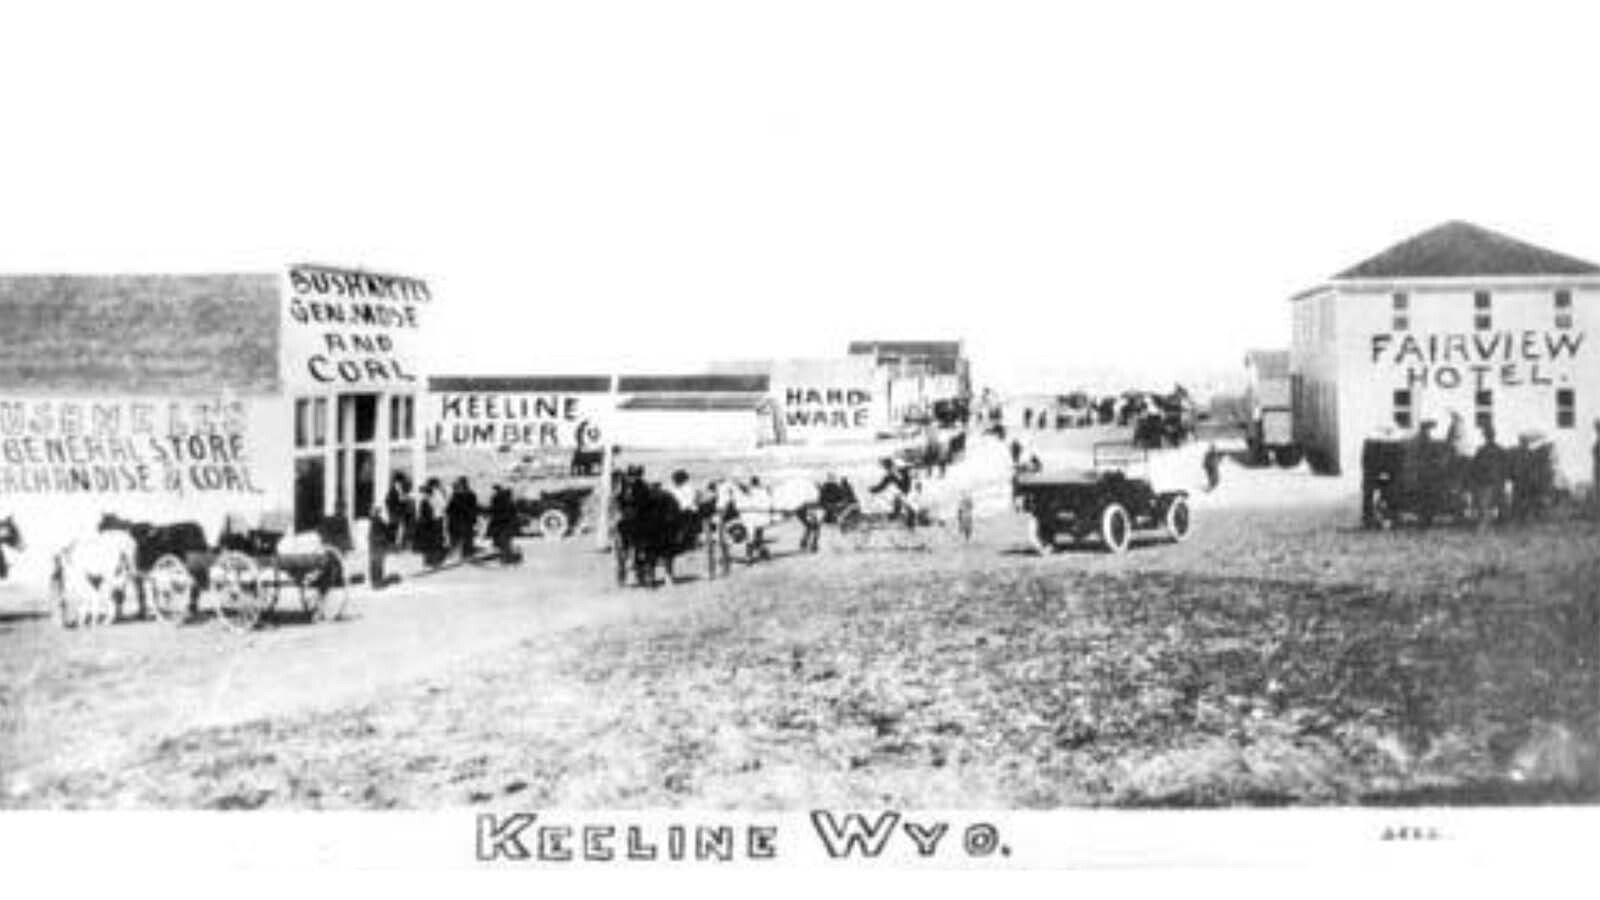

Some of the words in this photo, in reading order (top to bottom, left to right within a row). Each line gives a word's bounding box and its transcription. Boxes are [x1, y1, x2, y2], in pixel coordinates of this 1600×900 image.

[325, 333, 392, 354] AND
[1371, 331, 1586, 363] FAIRVIEW
[308, 354, 416, 382] COAL
[442, 395, 580, 421] KEELINE
[786, 408, 869, 428] WARE
[4, 434, 143, 463] GENERAL
[149, 434, 246, 462] STORE
[425, 422, 558, 449] LUMBER
[189, 465, 264, 495] COAL
